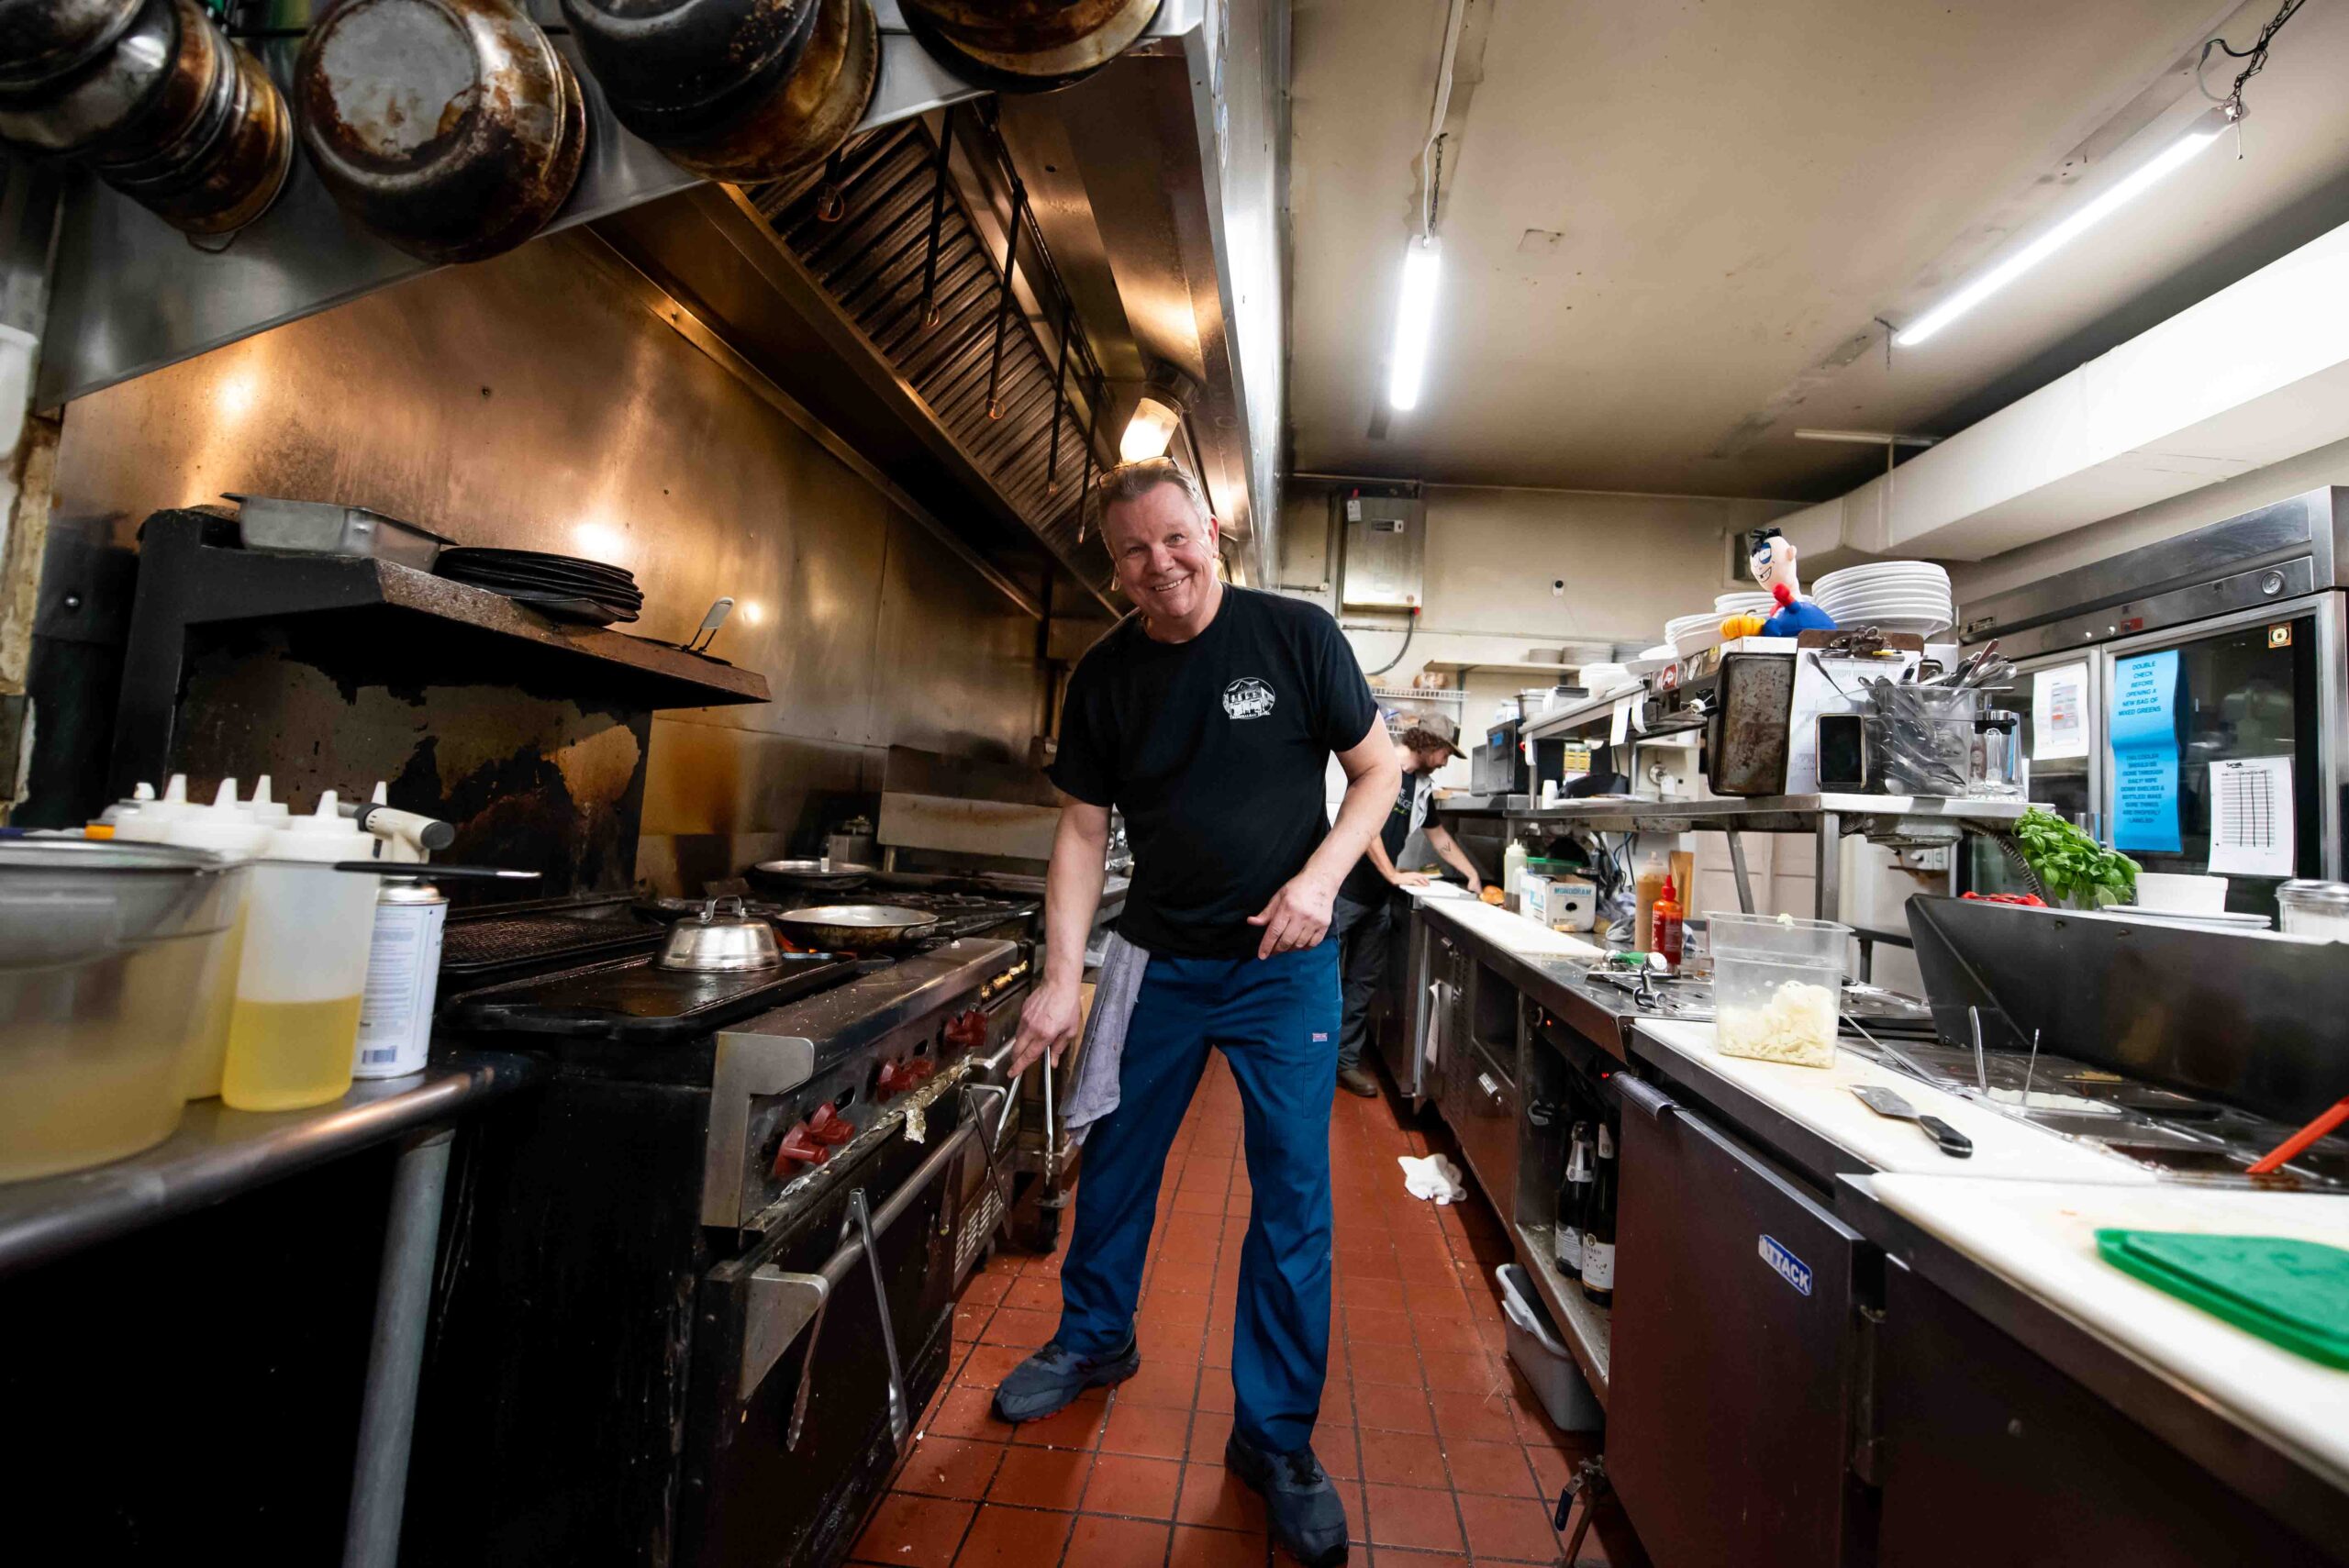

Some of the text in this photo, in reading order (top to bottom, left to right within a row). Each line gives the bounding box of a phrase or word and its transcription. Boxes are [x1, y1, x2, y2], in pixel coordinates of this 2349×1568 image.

[2132, 661, 2156, 671] DOUBLE
[2133, 671, 2153, 679] CHECK
[2131, 680, 2154, 688] BEFORE
[2126, 689, 2151, 697] OPENING
[2136, 706, 2162, 714] GREENS
